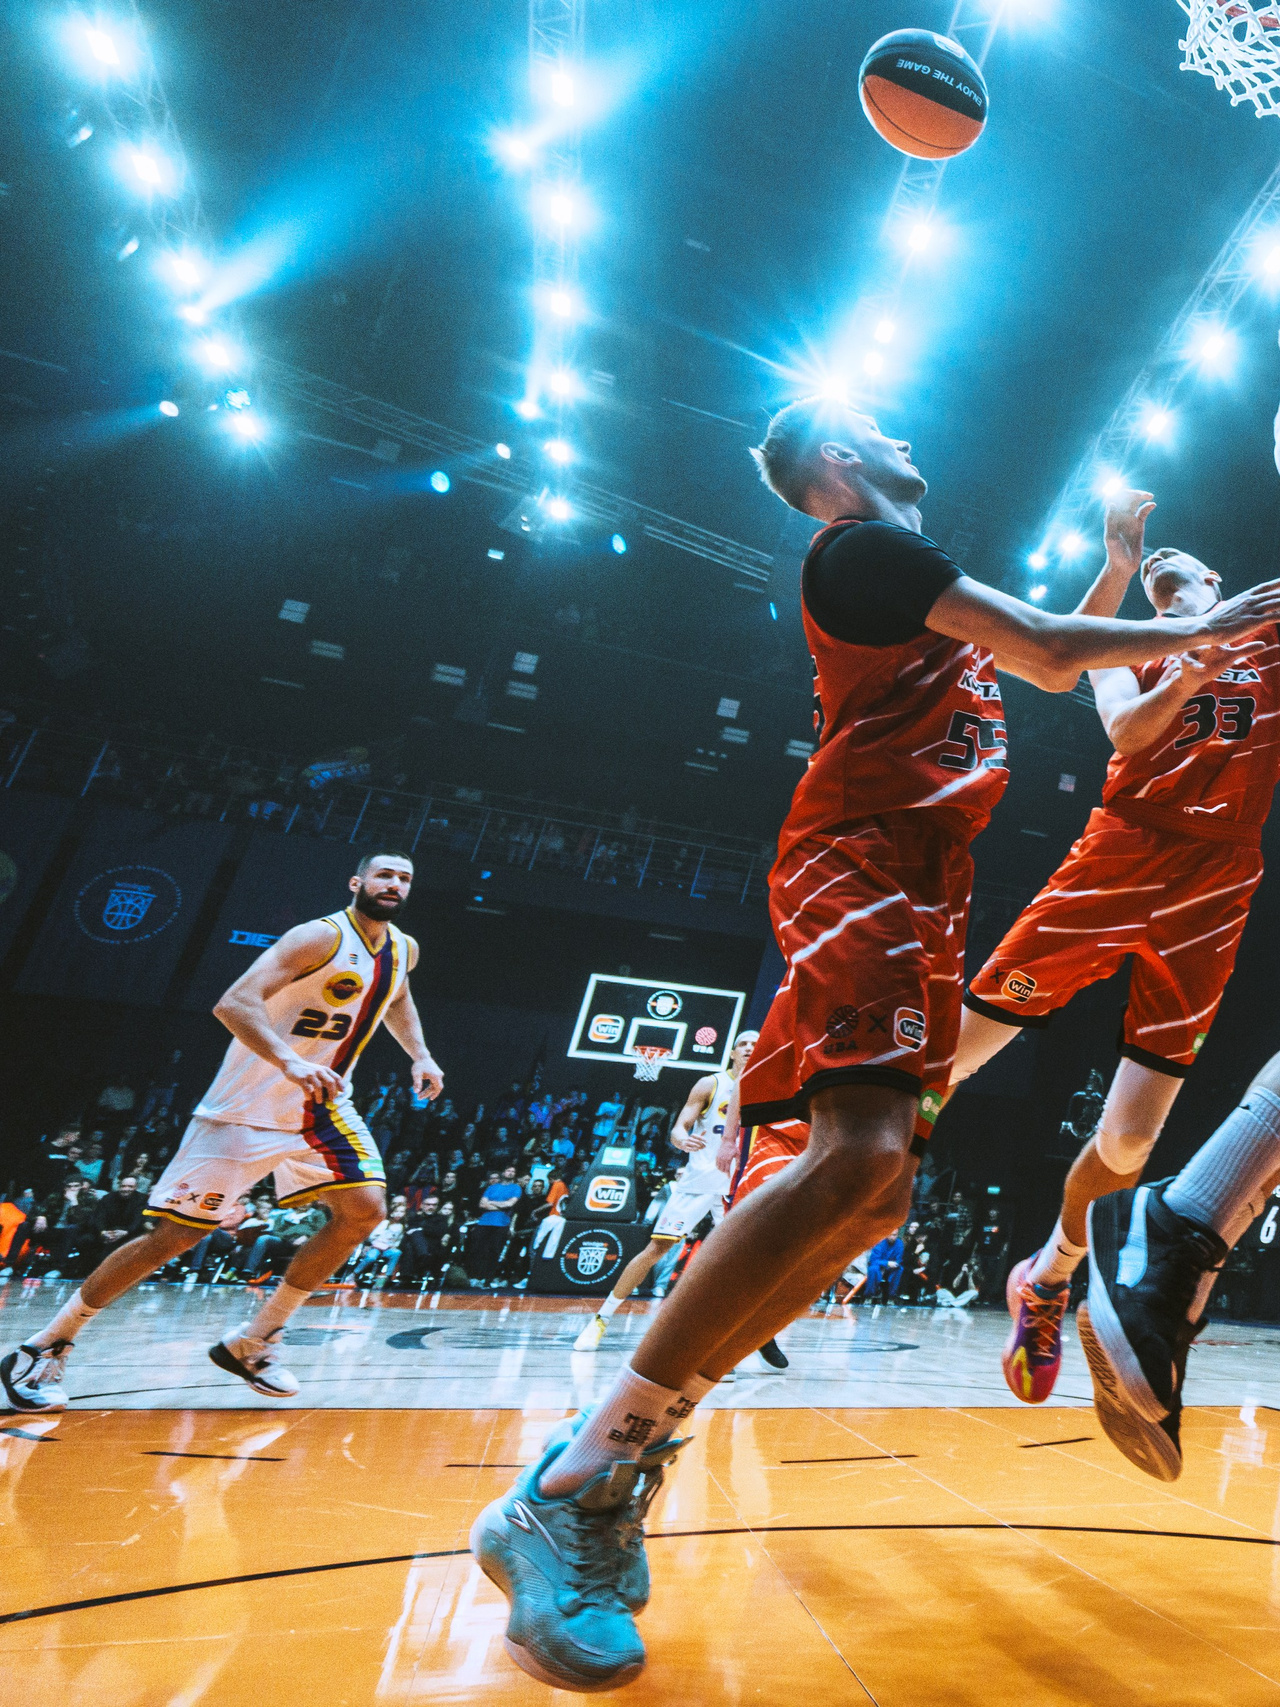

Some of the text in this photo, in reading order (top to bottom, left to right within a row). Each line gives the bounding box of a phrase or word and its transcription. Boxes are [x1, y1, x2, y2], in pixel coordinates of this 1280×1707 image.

[896, 58, 983, 107] ENJOY THE GAME
[1174, 693, 1256, 750] 33
[1011, 981, 1031, 996] Win
[290, 1008, 352, 1040] 23
[599, 1024, 619, 1035] Win
[596, 1188, 624, 1200] Win
[1260, 1205, 1280, 1244] 6
